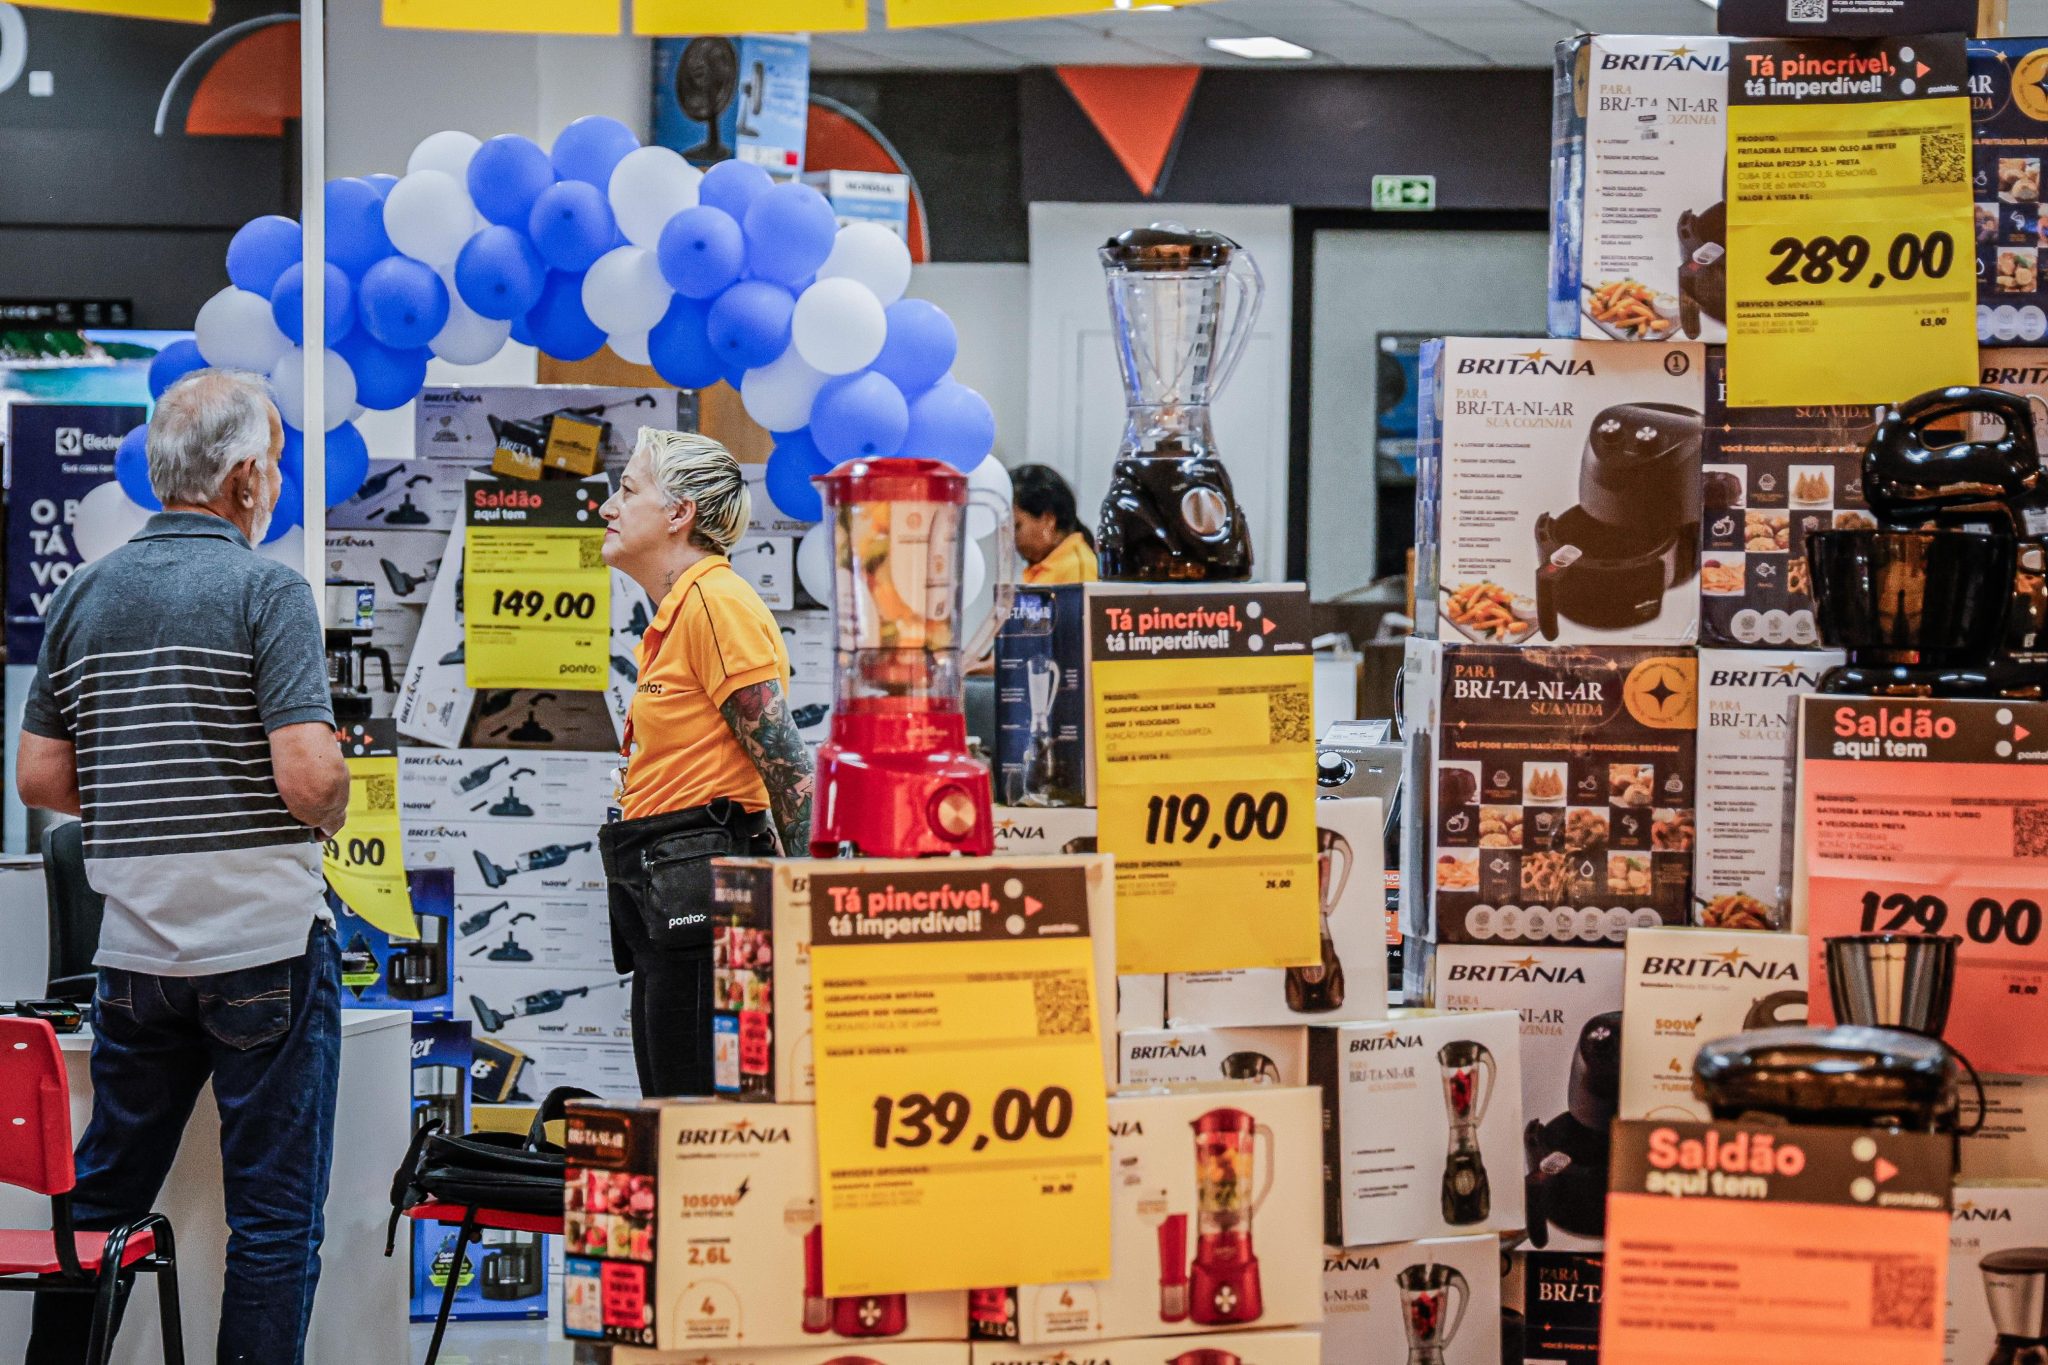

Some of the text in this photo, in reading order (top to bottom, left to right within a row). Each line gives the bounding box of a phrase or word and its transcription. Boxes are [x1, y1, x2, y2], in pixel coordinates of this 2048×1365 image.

[1746, 51, 1896, 80] Tá pincrível,
[1600, 84, 1632, 94] PARA
[1745, 75, 1882, 99] tá imperdível!
[1600, 97, 1718, 112] BRI-TANI-AR
[1738, 147, 1781, 155] FRITADEIRA
[1836, 158, 1860, 166] PRETA
[1766, 230, 1954, 289] 289,00
[1456, 388, 1488, 399] PARA
[1456, 400, 1575, 416] BRI-TA-NI-AR
[1512, 417, 1573, 429] COZINHA
[473, 489, 544, 509] Saldão
[30, 499, 57, 525] O
[473, 508, 527, 522] aqui tem
[29, 524, 68, 556] TÁ
[492, 588, 596, 622] 149,00
[1105, 605, 1243, 635] Tá pincrível,
[1105, 630, 1230, 654] tá imperdível!
[1455, 664, 1495, 678] PARA
[1709, 670, 1820, 688] BRITAN
[1454, 679, 1604, 701] BRI-TA-NI-AR
[1530, 702, 1604, 716] SUA VIDA
[1709, 700, 1741, 711] PARA
[1709, 713, 1789, 728] BRI-TA-N
[1835, 706, 1957, 739] Saldão
[1833, 738, 1928, 760] aqui tem
[1146, 791, 1288, 849] 119,00
[827, 882, 1000, 919] Tá pincrível,
[828, 910, 983, 939] tá imperdível!
[1860, 891, 2043, 946] 12900
[1655, 1018, 1697, 1030] 500W
[873, 1086, 1073, 1152] 139,00
[1648, 1127, 1807, 1177] Saldão
[1646, 1170, 1769, 1198] aqui tem
[688, 1247, 731, 1265] 2,6L
